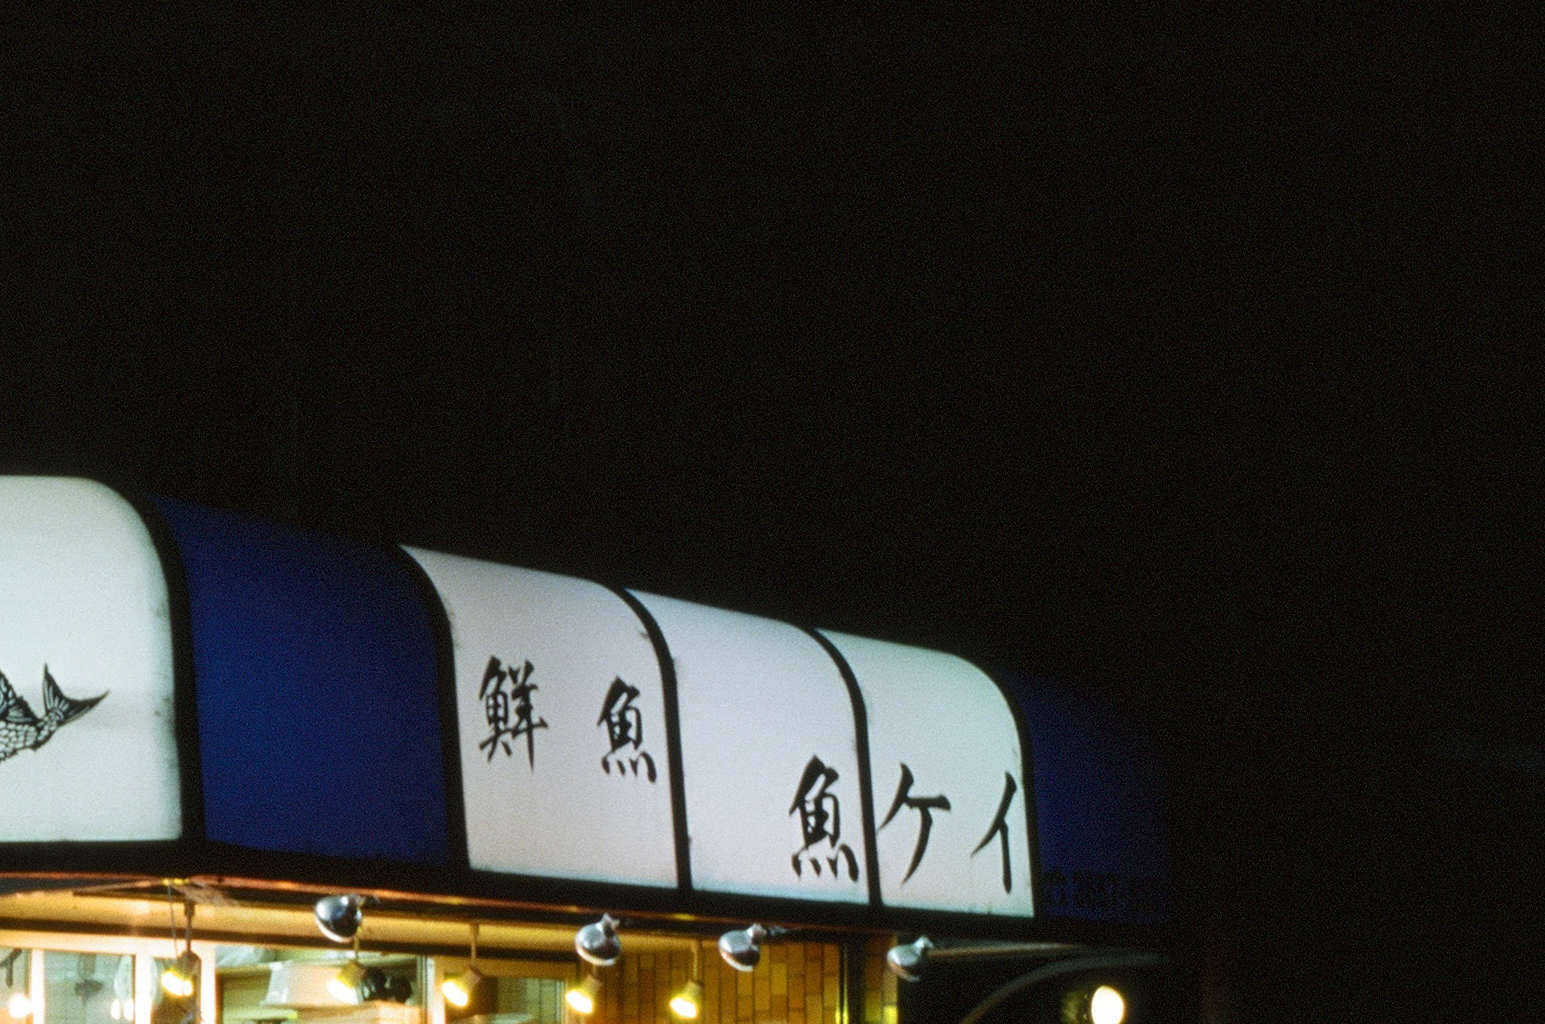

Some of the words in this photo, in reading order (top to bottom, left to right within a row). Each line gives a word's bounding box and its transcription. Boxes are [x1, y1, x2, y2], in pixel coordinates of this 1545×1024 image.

[478, 655, 658, 784] 鮮魚
[787, 754, 1018, 894] 魚ケイ
